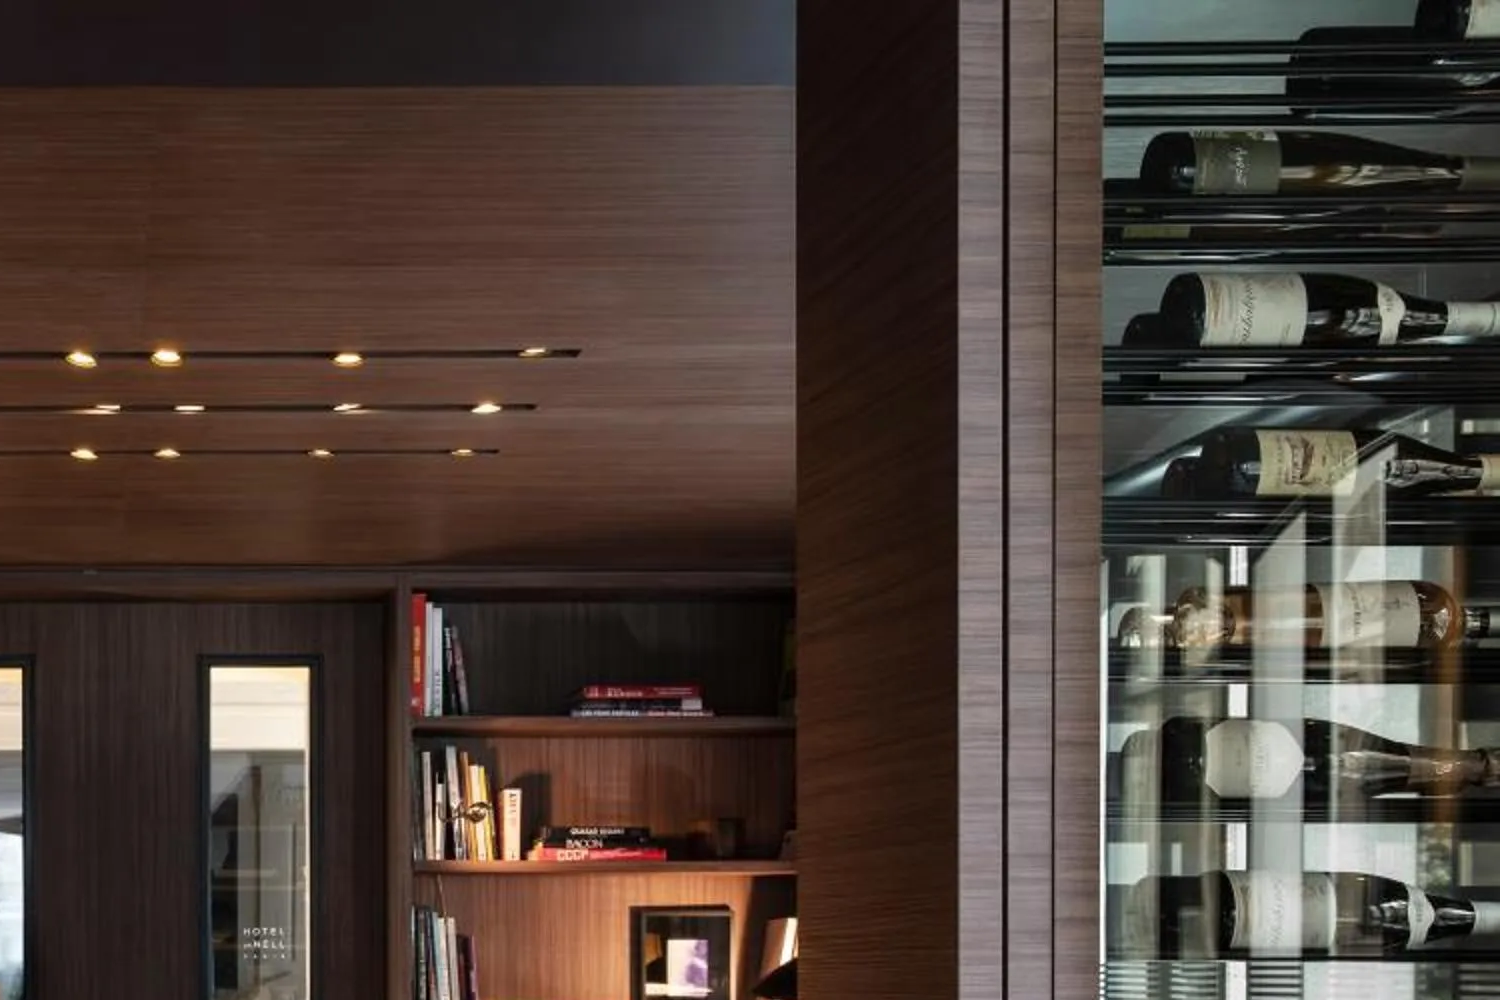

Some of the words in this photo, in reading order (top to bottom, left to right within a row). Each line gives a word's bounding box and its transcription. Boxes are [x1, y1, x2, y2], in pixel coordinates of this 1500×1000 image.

[566, 839, 603, 849] BACON
[243, 927, 284, 937] HOTEL
[253, 939, 285, 950] NELL
